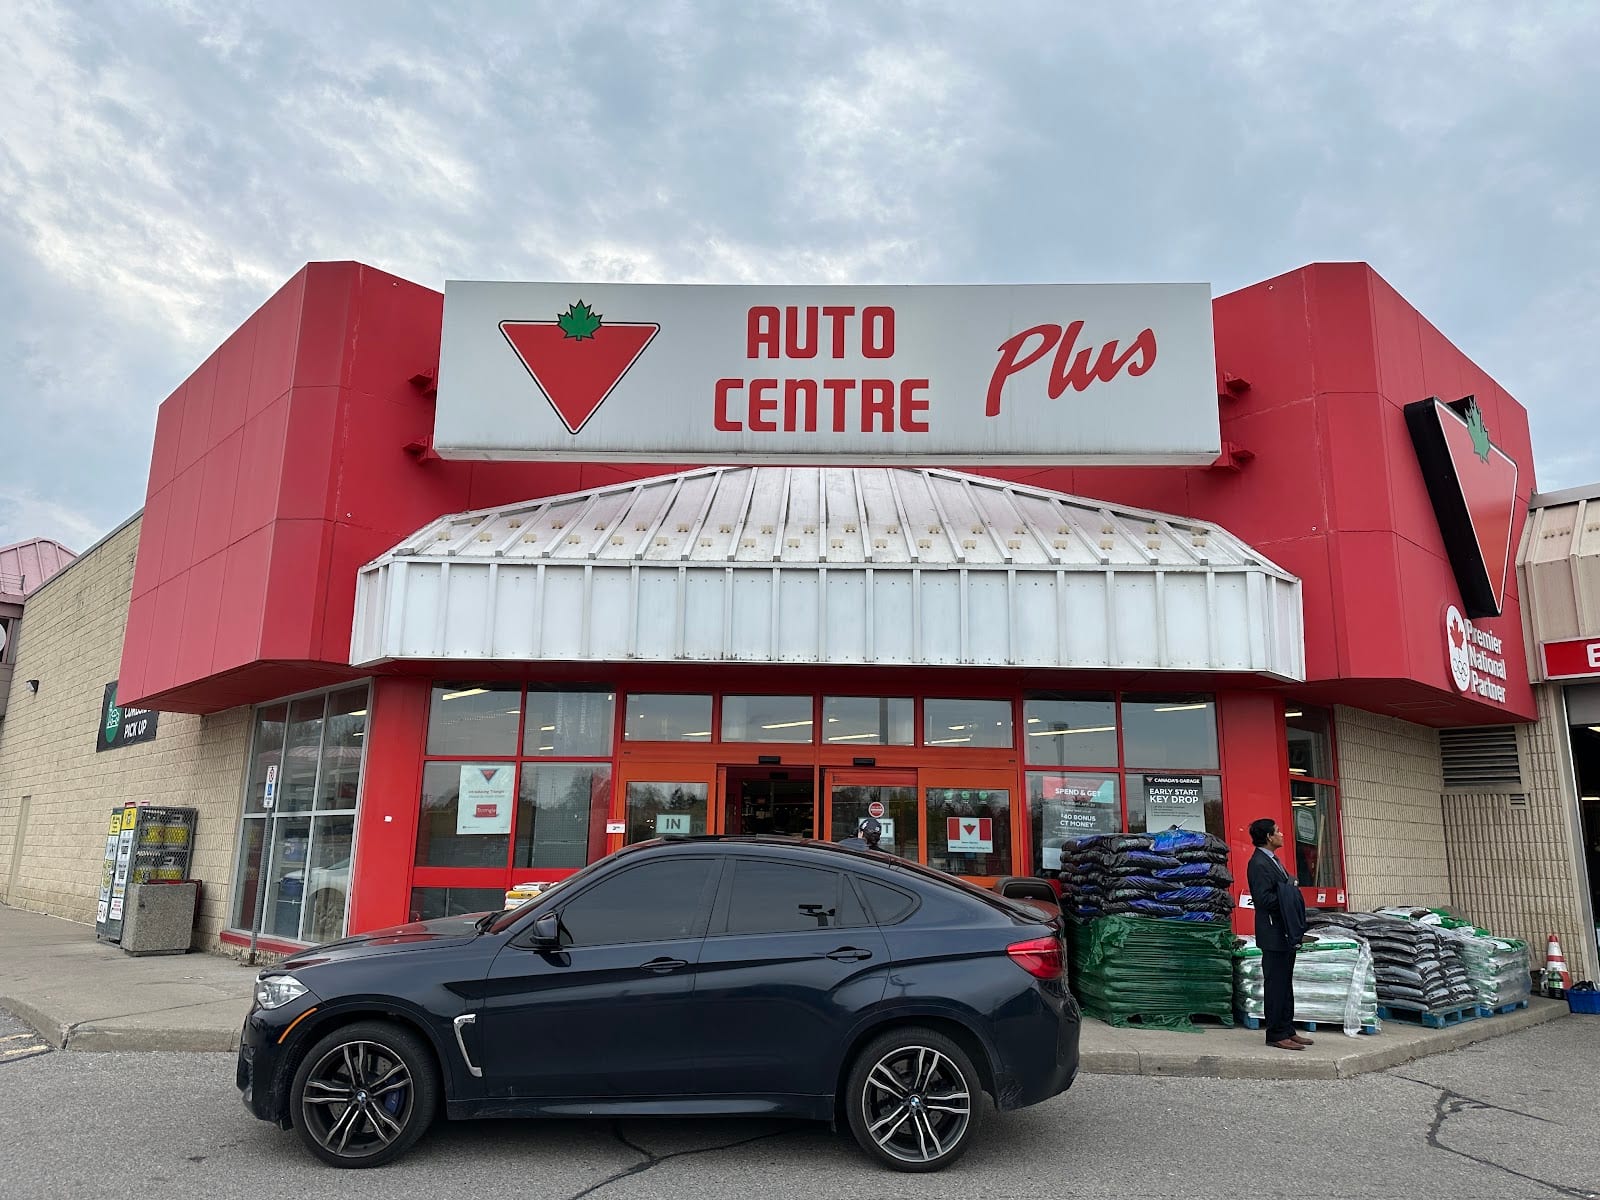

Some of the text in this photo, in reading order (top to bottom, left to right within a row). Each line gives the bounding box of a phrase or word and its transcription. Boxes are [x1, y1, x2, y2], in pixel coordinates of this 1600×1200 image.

[747, 306, 895, 358] AUTO
[985, 320, 1157, 416] Plus
[714, 378, 929, 432] CENTRE
[1464, 618, 1502, 655] Premier
[1467, 644, 1507, 680] National
[1471, 670, 1506, 703] Partner
[124, 719, 147, 739] PICK UP
[1055, 788, 1079, 796] SPEND
[1150, 795, 1199, 804] KEY DROP
[1174, 788, 1199, 796] START
[666, 818, 681, 830] IN
[1073, 814, 1097, 822] BONUS
